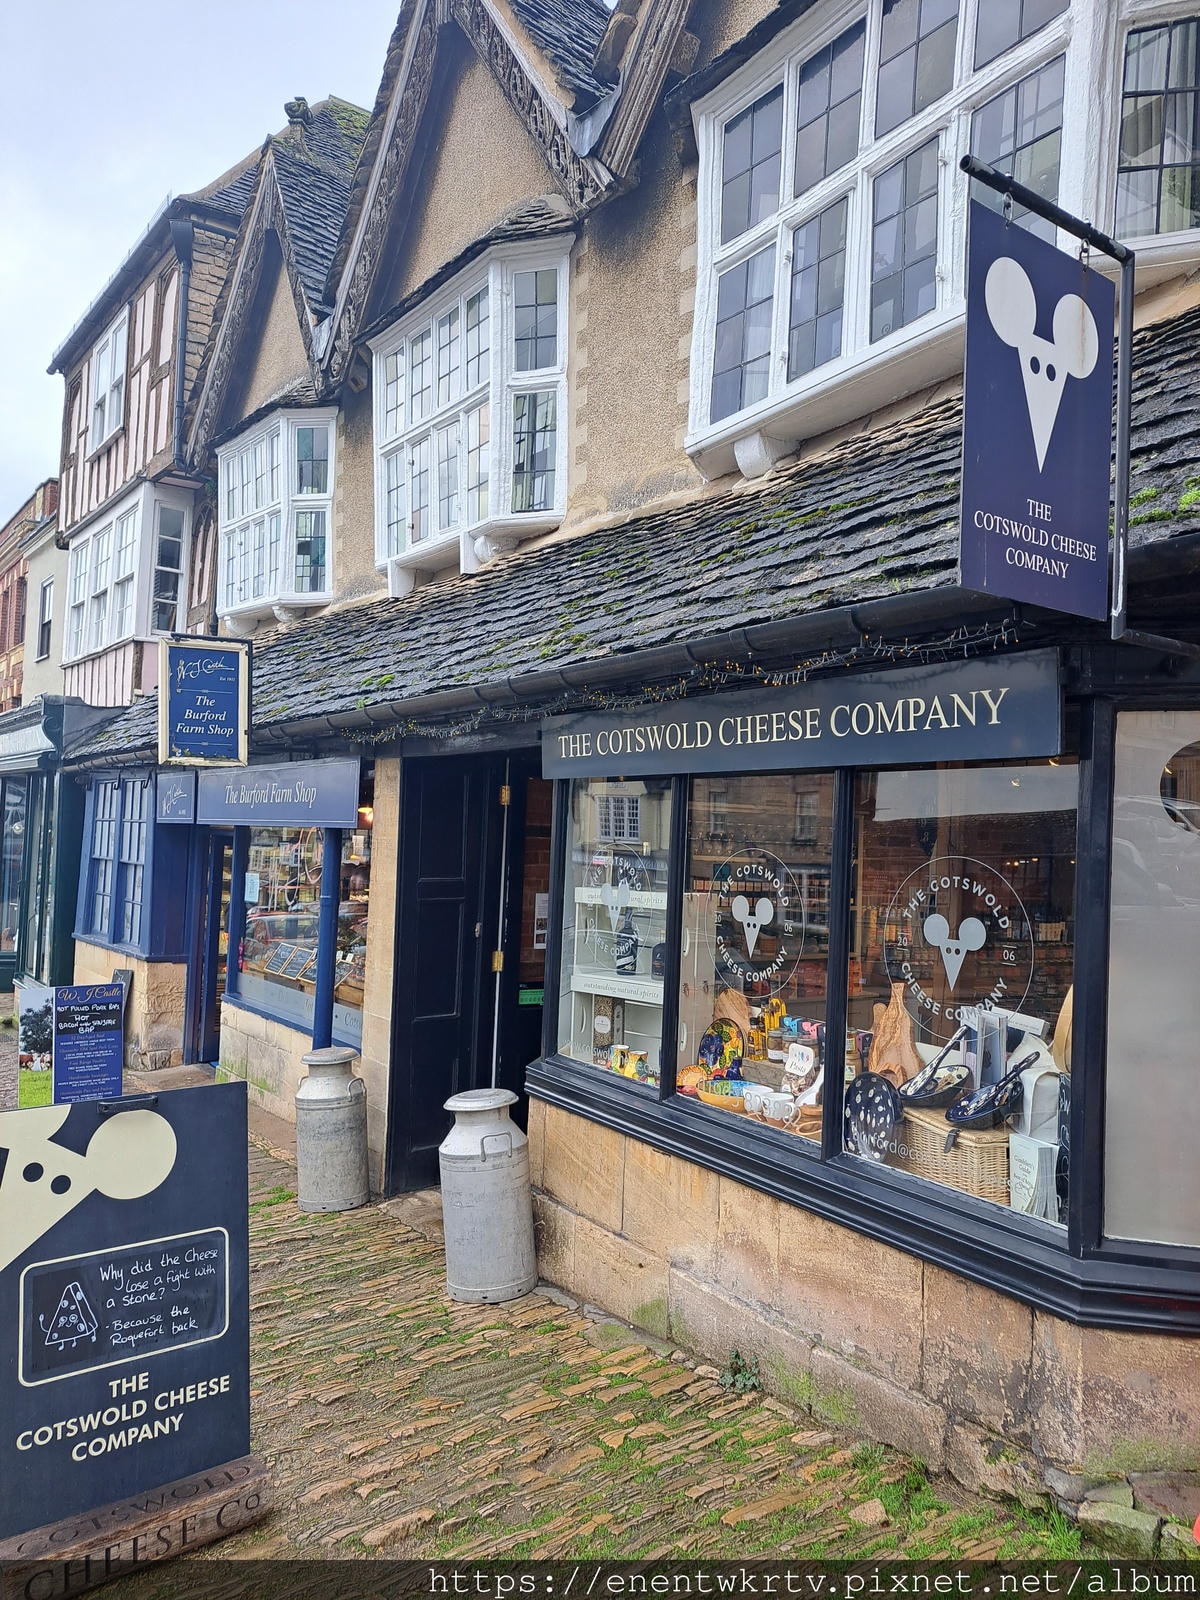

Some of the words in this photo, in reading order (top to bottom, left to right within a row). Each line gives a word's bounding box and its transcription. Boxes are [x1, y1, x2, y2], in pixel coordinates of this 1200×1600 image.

[1027, 498, 1052, 522] THE
[974, 510, 1049, 547] COTSWOLD
[1051, 533, 1097, 562] CHEESE
[1006, 547, 1069, 579] COMPANY
[195, 695, 216, 707] The
[176, 722, 205, 734] Farm
[207, 724, 234, 738] Shop
[184, 709, 227, 723] Burford
[558, 733, 593, 759] THE
[596, 721, 713, 756] COTSWOLD
[718, 707, 822, 747] CHEESE
[830, 687, 1010, 738] COMPANY
[225, 784, 239, 804] The
[239, 781, 270, 809] Burford
[270, 782, 293, 804] Farm
[294, 780, 317, 809] Shop
[718, 875, 734, 900] THE
[737, 864, 790, 907] COTSWOLD
[903, 889, 927, 919] THE
[930, 876, 1010, 929] COTSWOLD
[784, 923, 793, 933] 06
[897, 936, 908, 947] 20
[716, 935, 744, 978] CHEESE
[745, 945, 788, 982] COMPANY
[1002, 950, 1016, 961] 06
[617, 985, 640, 996] natural
[640, 989, 659, 999] spirits
[901, 962, 941, 1015] CHEESE
[945, 977, 1008, 1021] COMPANY
[78, 1026, 95, 1034] BAP
[100, 1263, 124, 1291] Why
[130, 1258, 153, 1275] did
[160, 1253, 180, 1267] the
[184, 1247, 219, 1262] Cheese
[154, 1276, 163, 1286] a
[166, 1268, 191, 1291] fight
[194, 1263, 216, 1277] with
[106, 1298, 116, 1309] a
[111, 1314, 163, 1331] Because
[170, 1305, 191, 1317] the
[109, 1324, 165, 1348] Roquefort
[171, 1317, 199, 1335] back
[108, 1371, 150, 1398] THE
[16, 1399, 148, 1452] COTSWOLD
[154, 1374, 231, 1411] CHEESE
[71, 1413, 184, 1462] COMPANY
[24, 1514, 198, 1600] CHEESE
